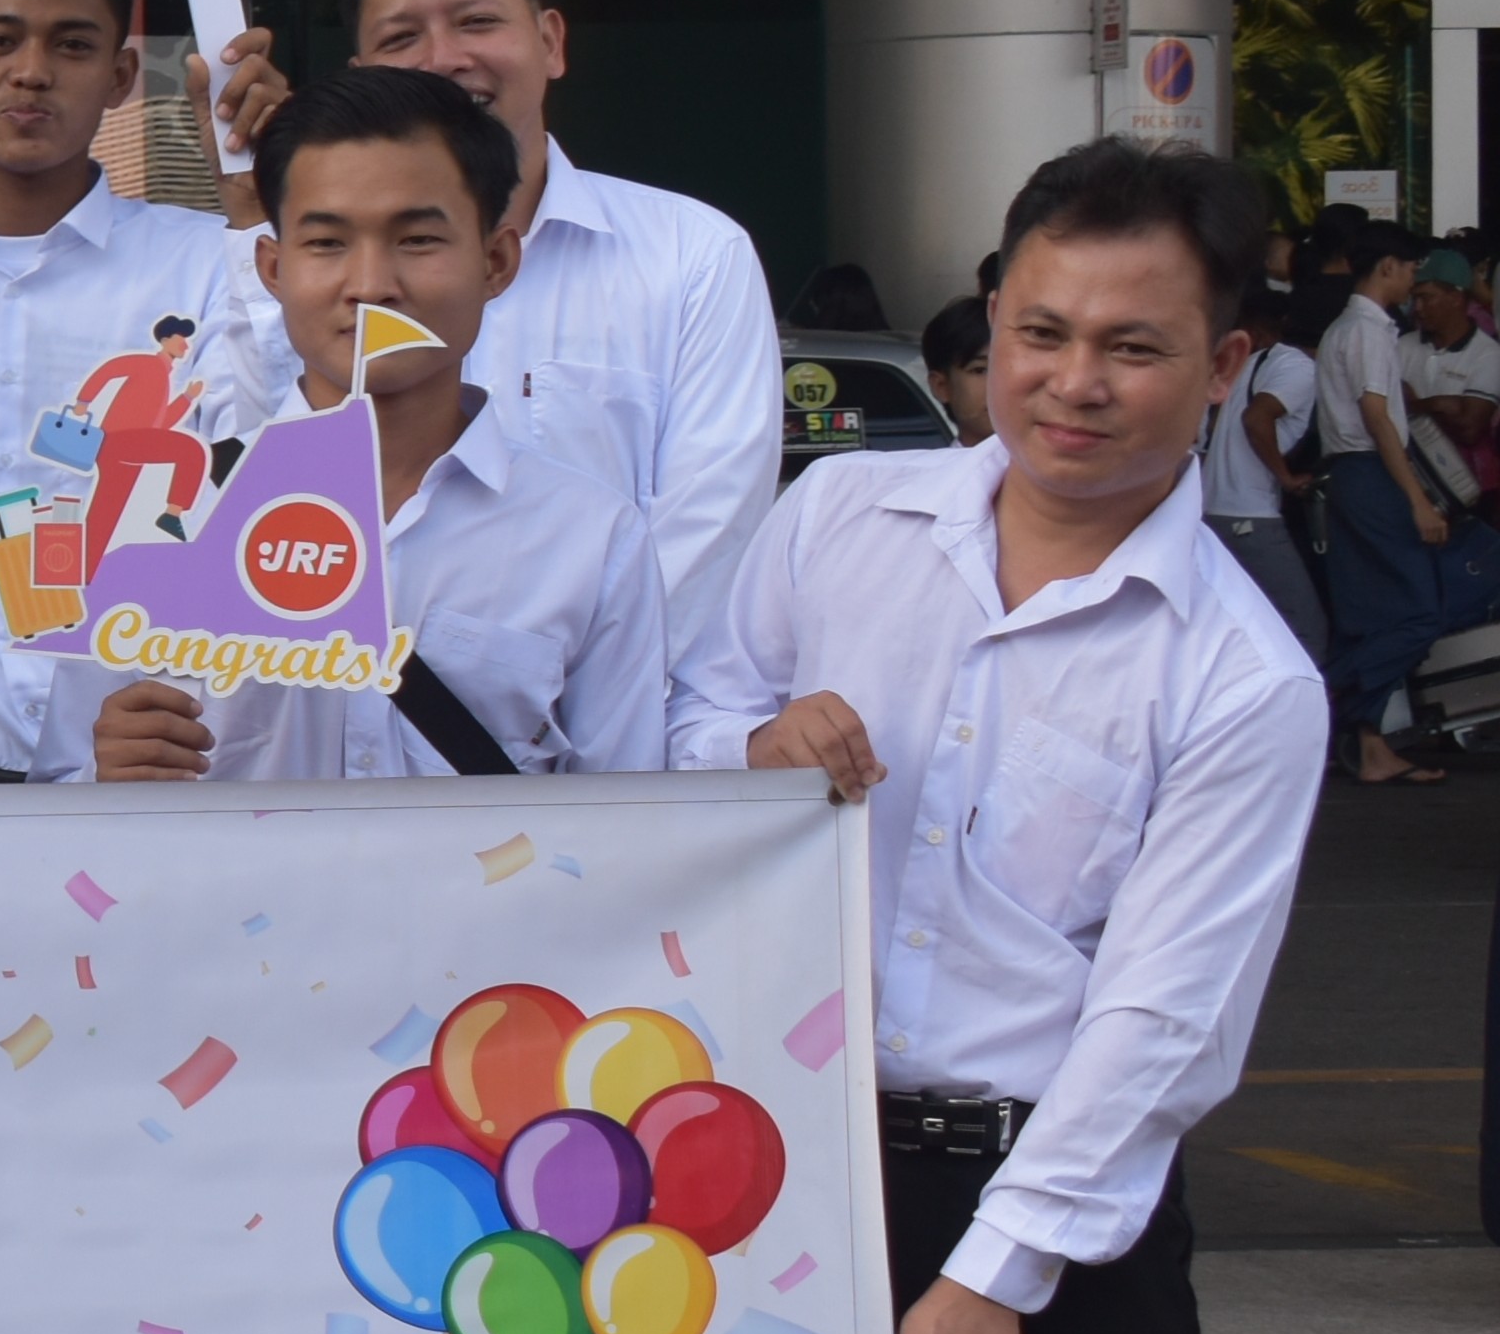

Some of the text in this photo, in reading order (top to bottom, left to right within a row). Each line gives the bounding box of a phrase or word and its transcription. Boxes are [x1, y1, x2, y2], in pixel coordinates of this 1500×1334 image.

[792, 384, 828, 403] 057
[805, 412, 860, 430] STAR
[257, 539, 348, 576] JRF
[96, 609, 407, 692] Congrats!
